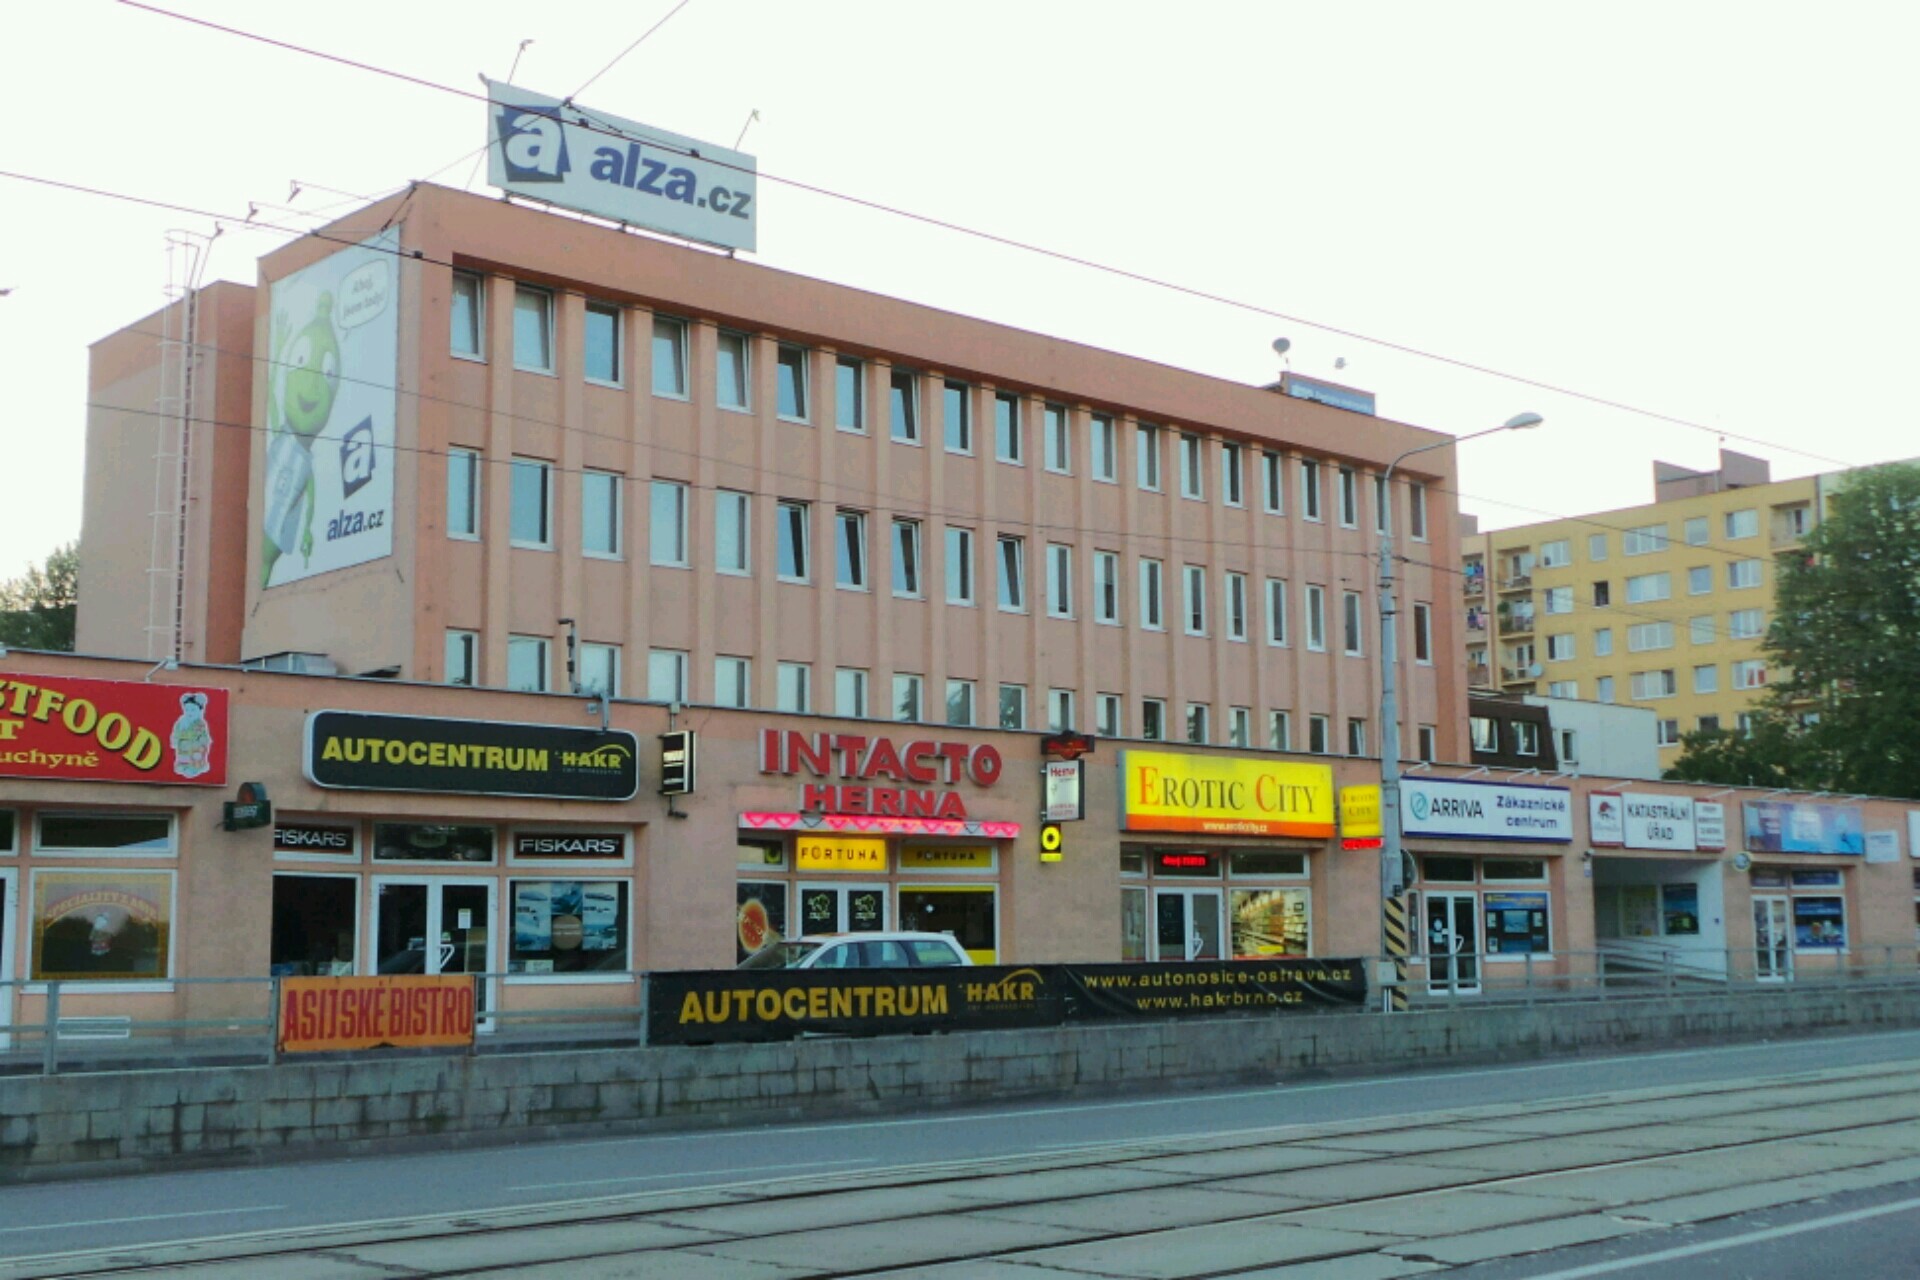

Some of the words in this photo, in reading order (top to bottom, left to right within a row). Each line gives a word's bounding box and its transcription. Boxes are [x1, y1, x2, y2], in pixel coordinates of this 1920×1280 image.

[590, 142, 752, 219] alza.cz
[326, 509, 384, 541] alza.cz
[0, 679, 162, 770] TFOOD
[322, 736, 548, 772] AUTOCENTRUM
[562, 752, 622, 769] HAKR
[759, 728, 1002, 786] INTACTO
[800, 783, 967, 818] HERNA
[1430, 798, 1484, 819] ARRIVA
[1496, 795, 1565, 812] Zákaznické
[1506, 816, 1557, 829] centrum
[520, 839, 616, 852] FISKARS
[1084, 967, 1352, 988] www.autonosice-ostrava.cz
[284, 980, 385, 1041] ASIJSKÉ
[389, 986, 472, 1037] BISTRO
[679, 984, 948, 1024] AUTOCENTRUM
[966, 982, 1034, 1001] HAKR
